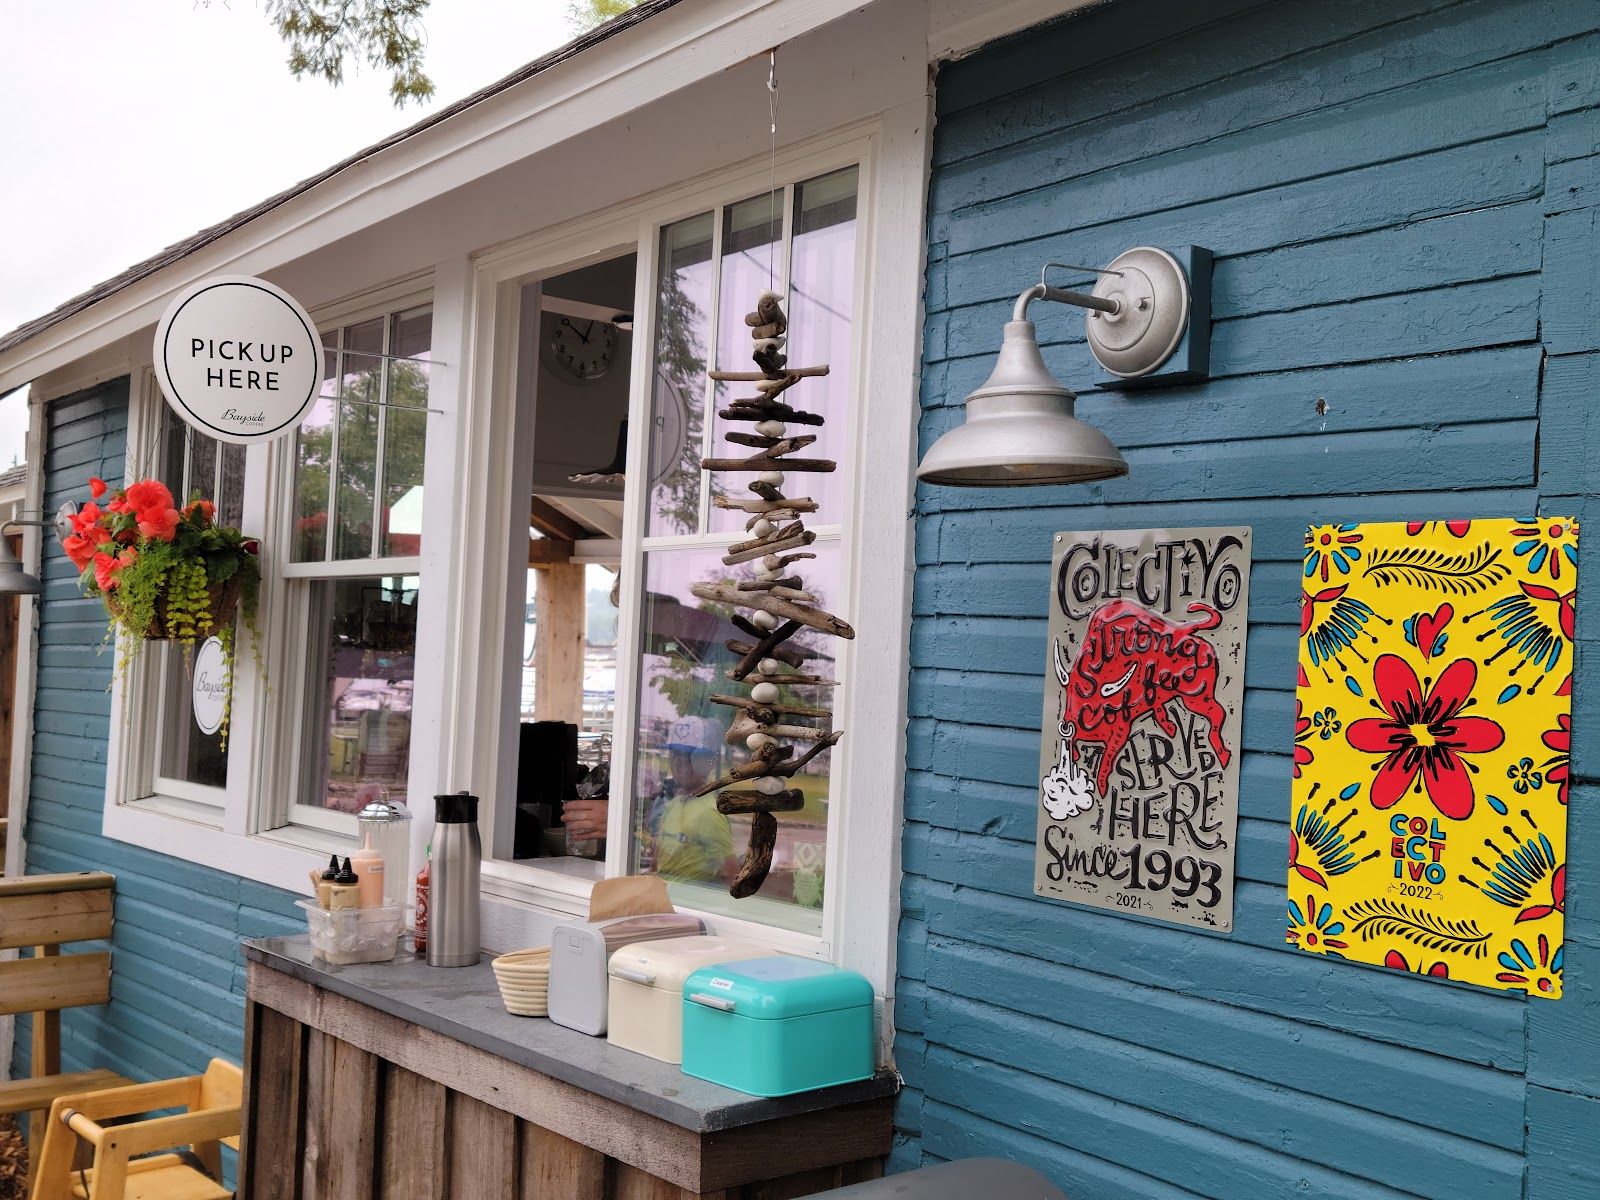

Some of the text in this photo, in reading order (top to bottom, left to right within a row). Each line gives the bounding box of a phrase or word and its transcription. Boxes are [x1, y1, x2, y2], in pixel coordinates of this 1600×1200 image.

[191, 338, 293, 364] PICKUP
[207, 367, 279, 391] HERE
[221, 408, 266, 425] Bayside
[1115, 705, 1216, 792] SERVED
[1108, 770, 1228, 851] HERE
[1389, 813, 1447, 841] COL
[1390, 835, 1446, 862] ECT
[1044, 824, 1222, 908] Since 1993
[1394, 859, 1447, 885] IVO
[1116, 892, 1142, 909] 2021
[1399, 882, 1433, 900] 2022
